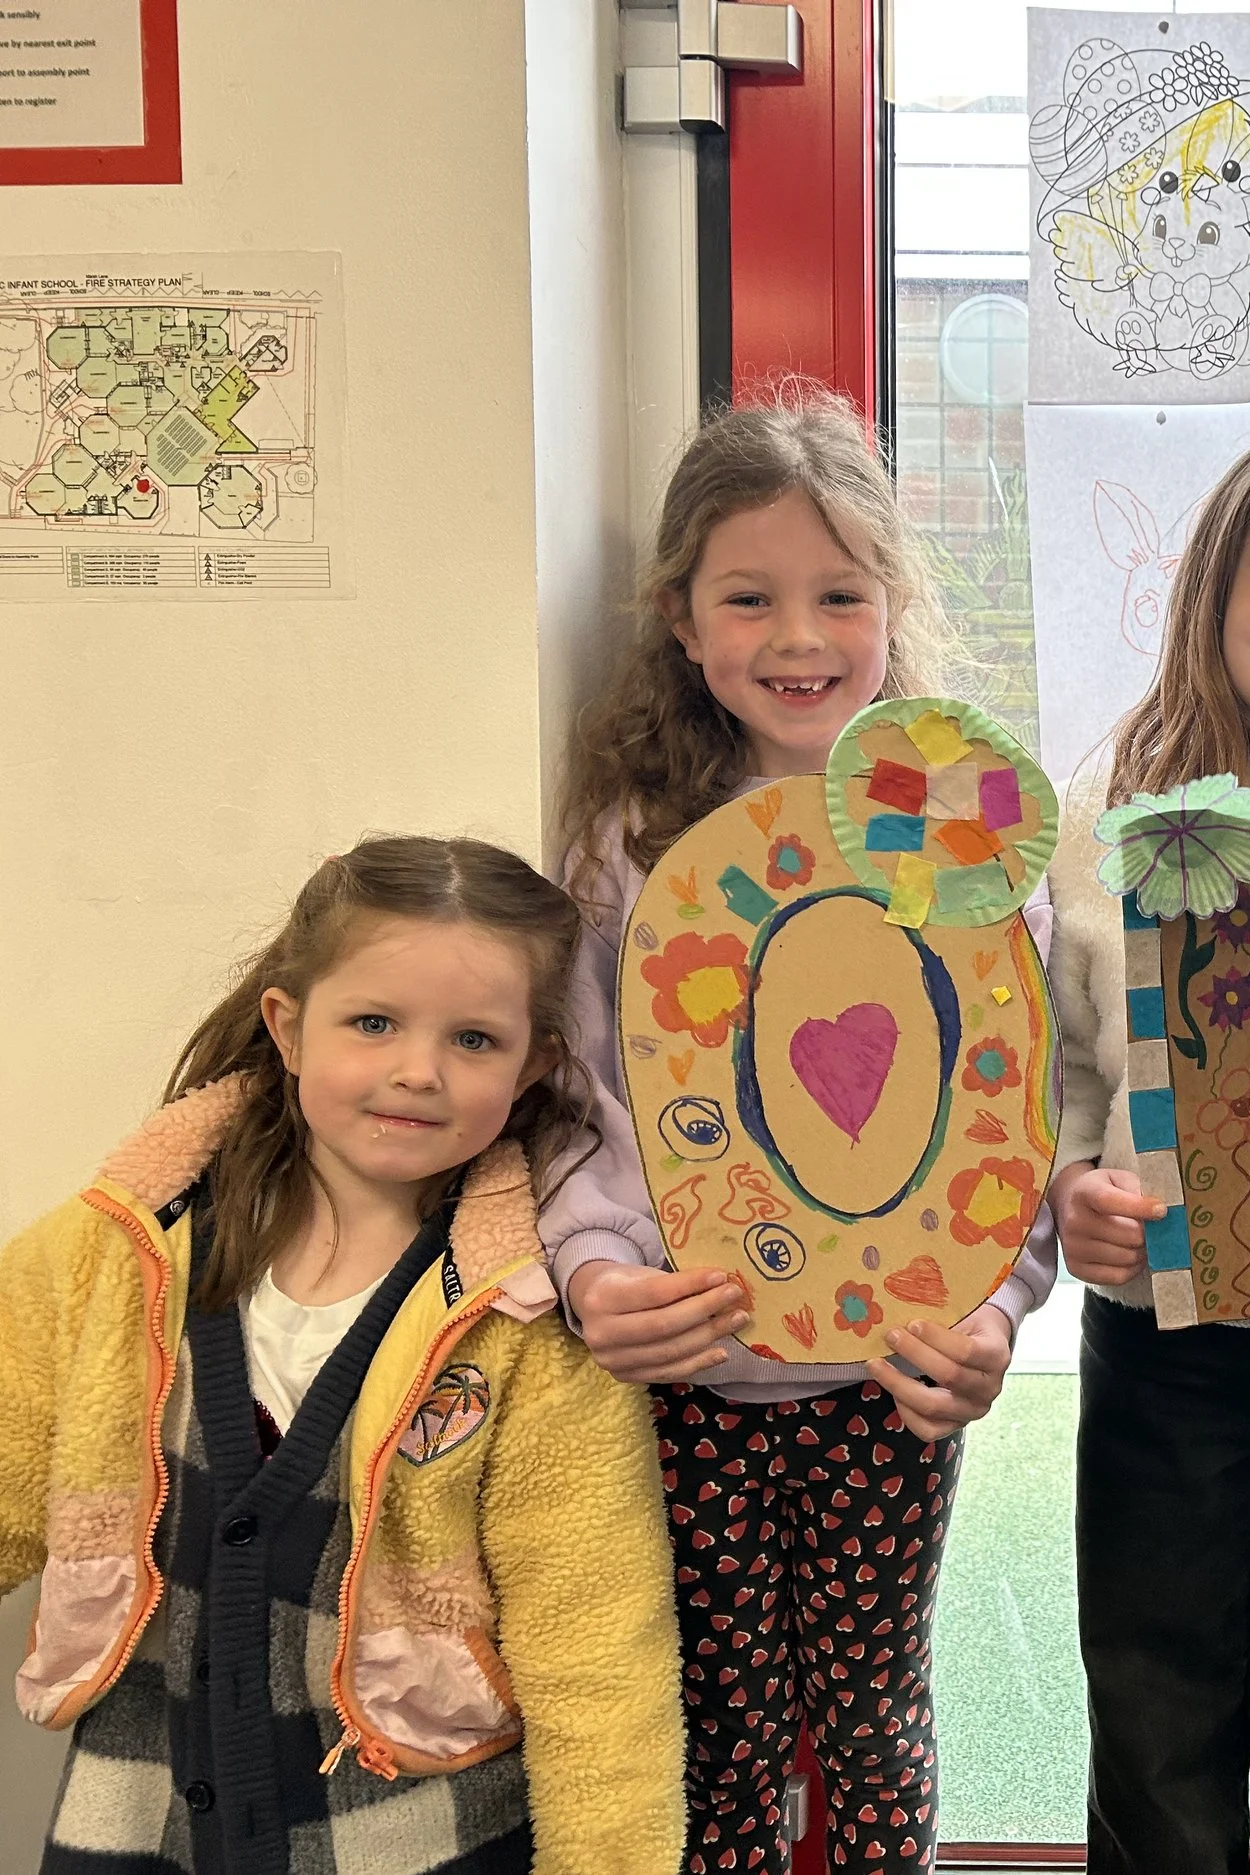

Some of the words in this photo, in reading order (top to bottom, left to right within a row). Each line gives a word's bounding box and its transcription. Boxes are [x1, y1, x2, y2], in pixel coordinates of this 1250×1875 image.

[7, 10, 40, 20] sensibly
[11, 39, 21, 49] by
[23, 40, 55, 48] nearest
[56, 39, 72, 47] exit
[74, 39, 96, 49] point
[28, 68, 65, 77] assembly
[68, 68, 90, 77] point
[14, 98, 23, 106] to
[25, 97, 57, 107] register
[7, 280, 39, 289] INFANT
[41, 280, 78, 289] SCHOOL
[86, 279, 105, 287] FIRE
[107, 278, 156, 287] STRATEGY
[158, 278, 181, 287] PLAN
